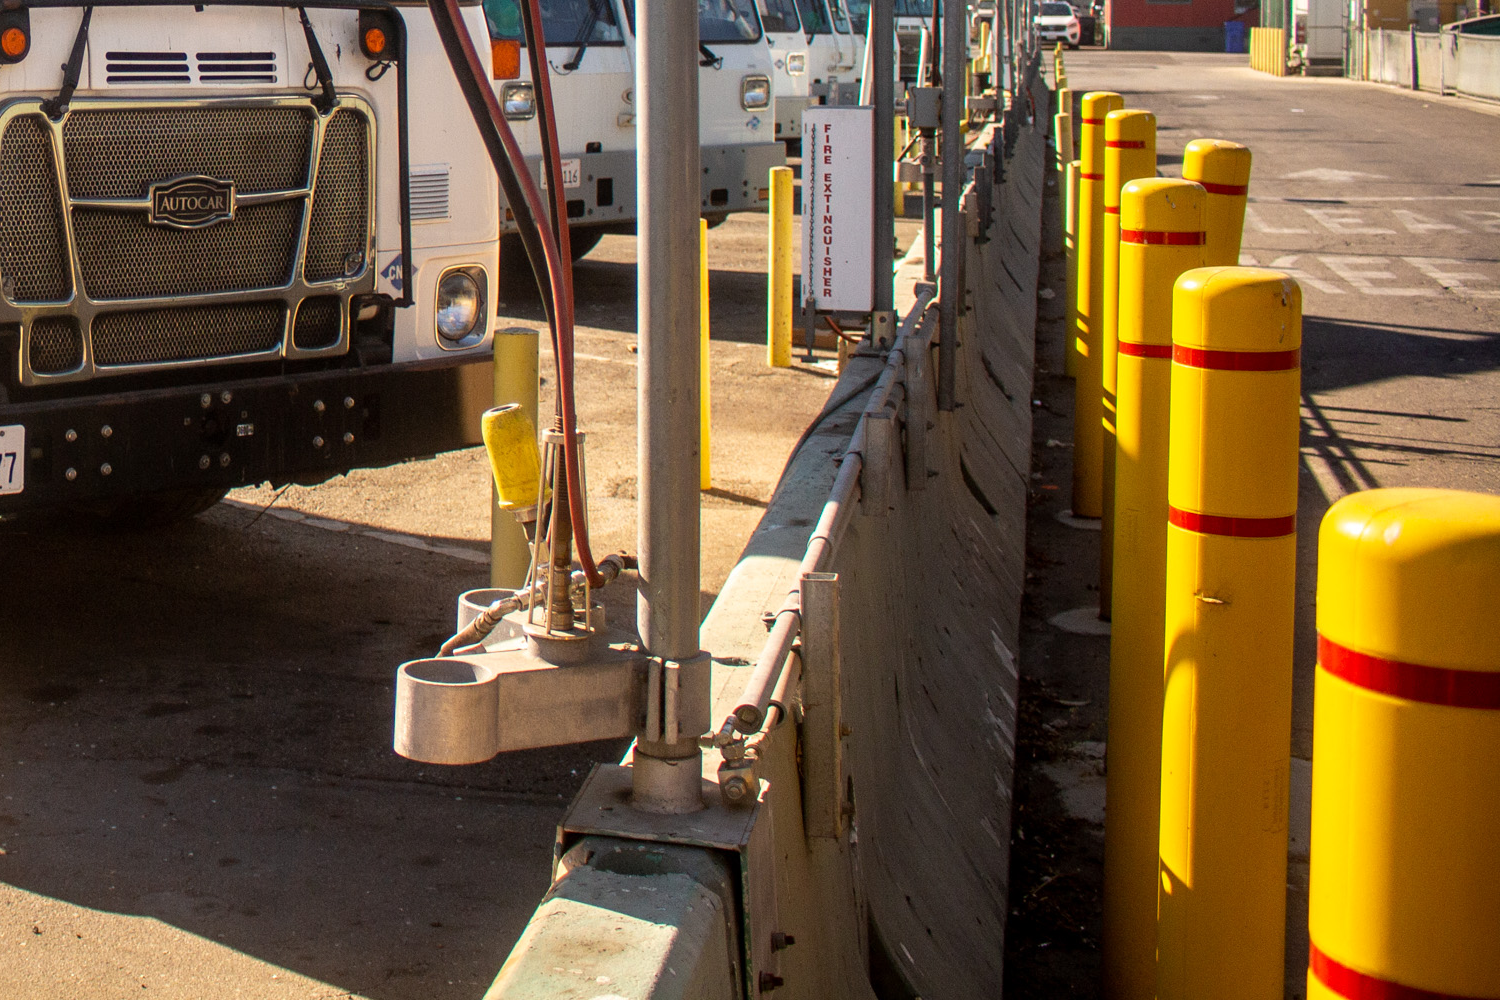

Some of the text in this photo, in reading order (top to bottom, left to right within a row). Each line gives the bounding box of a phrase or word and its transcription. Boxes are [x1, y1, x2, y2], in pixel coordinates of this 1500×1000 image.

[824, 124, 832, 164] FIRE
[160, 195, 224, 211] AUTOCAR
[823, 173, 832, 297] EXTINGUISHER
[388, 264, 403, 280] CN
